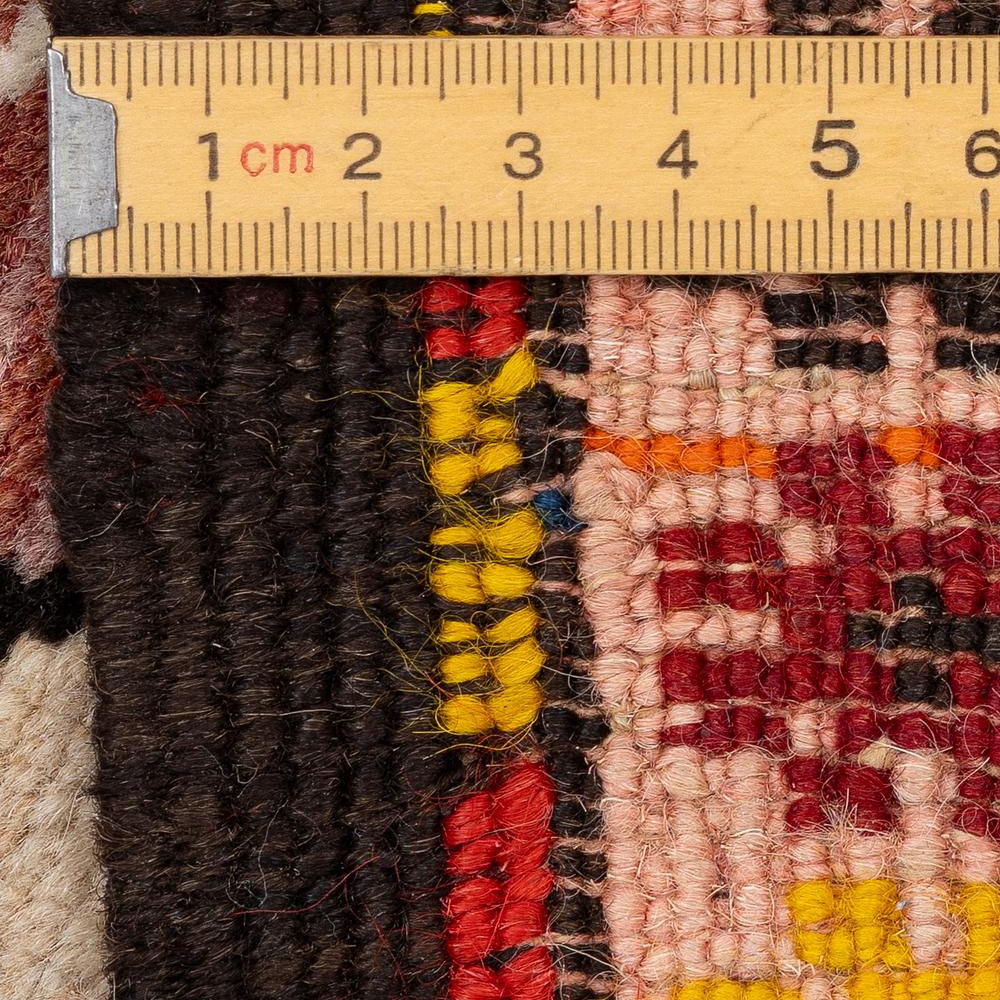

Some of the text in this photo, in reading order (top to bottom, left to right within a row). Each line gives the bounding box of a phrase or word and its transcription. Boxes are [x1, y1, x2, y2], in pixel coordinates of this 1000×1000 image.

[198, 131, 219, 182] 1
[239, 139, 315, 178] cm
[342, 132, 382, 181] 2
[502, 131, 544, 181] 3
[656, 129, 699, 179] 4
[809, 119, 860, 180] 5
